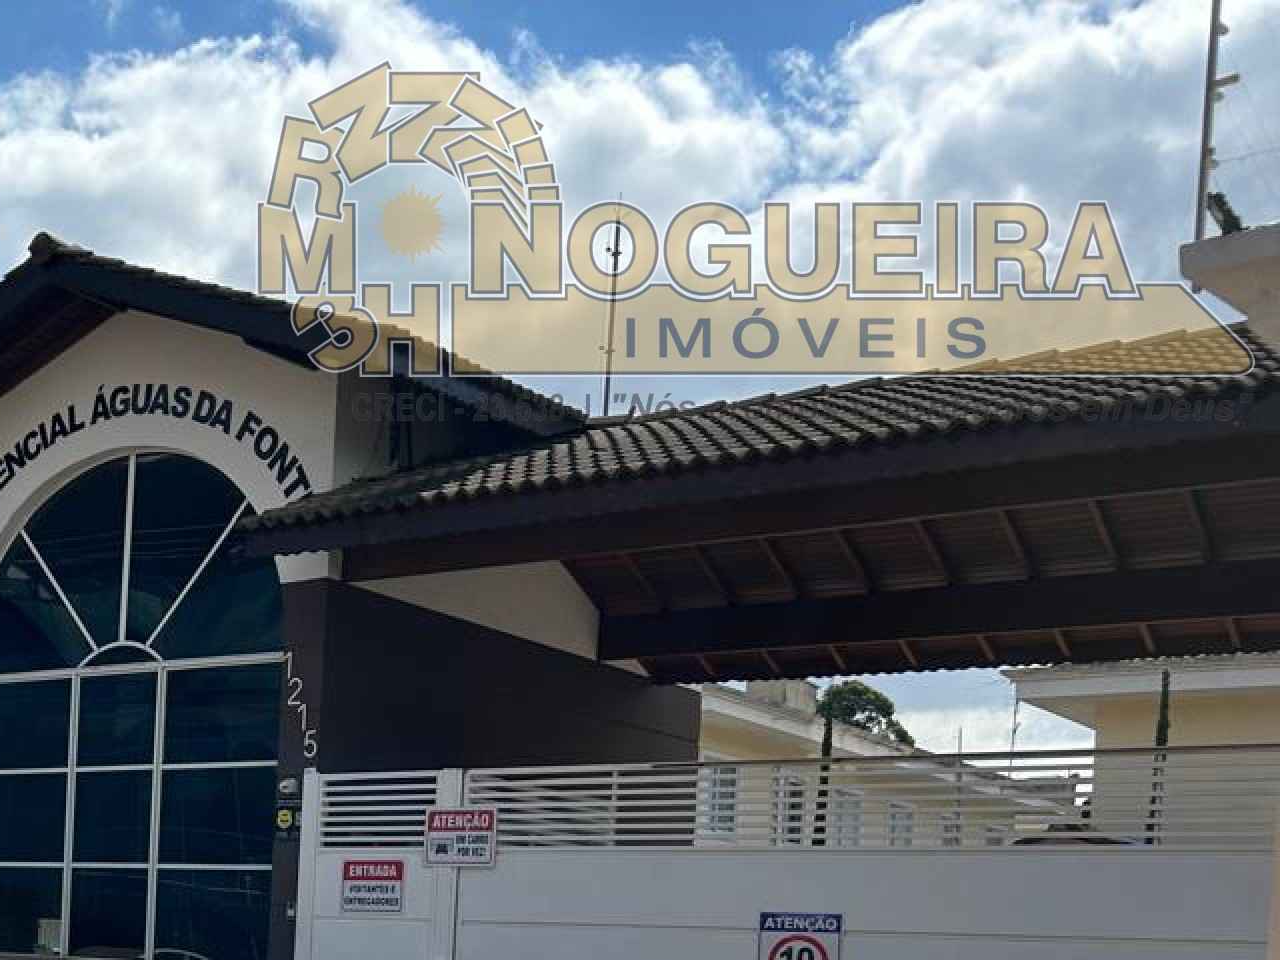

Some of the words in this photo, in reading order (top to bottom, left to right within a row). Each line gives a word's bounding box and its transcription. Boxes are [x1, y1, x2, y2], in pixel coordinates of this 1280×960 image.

[90, 383, 193, 425] ÁGUAS
[191, 390, 236, 435] DA
[235, 411, 313, 499] FONT
[283, 651, 318, 759] 1215
[432, 811, 489, 831] ATENÇÃO
[349, 863, 397, 878] ENTRADA
[763, 915, 838, 931] ATENÇÃO
